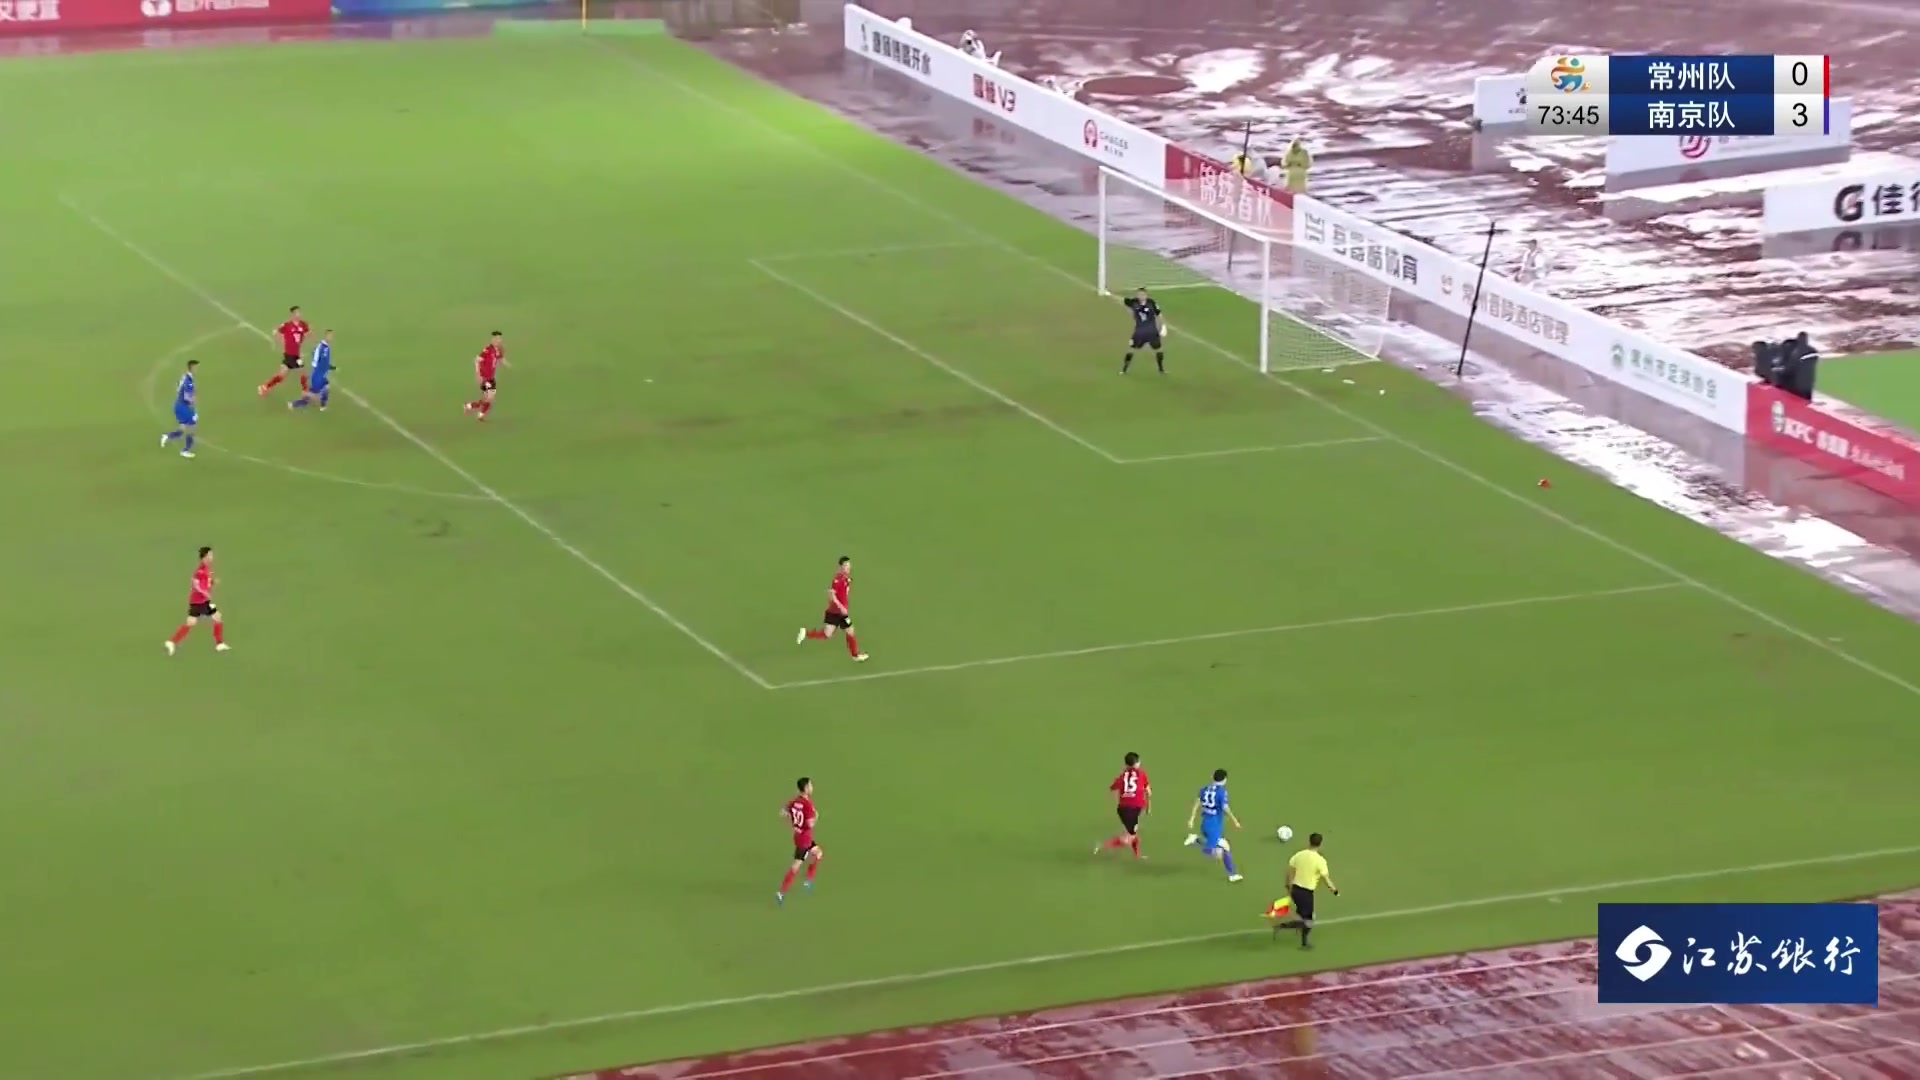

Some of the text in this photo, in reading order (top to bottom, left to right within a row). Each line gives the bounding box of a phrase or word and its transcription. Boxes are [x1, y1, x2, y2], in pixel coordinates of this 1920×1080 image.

[1784, 418, 1815, 444] KFC
[1123, 775, 1138, 792] 15
[1202, 790, 1217, 808] 33
